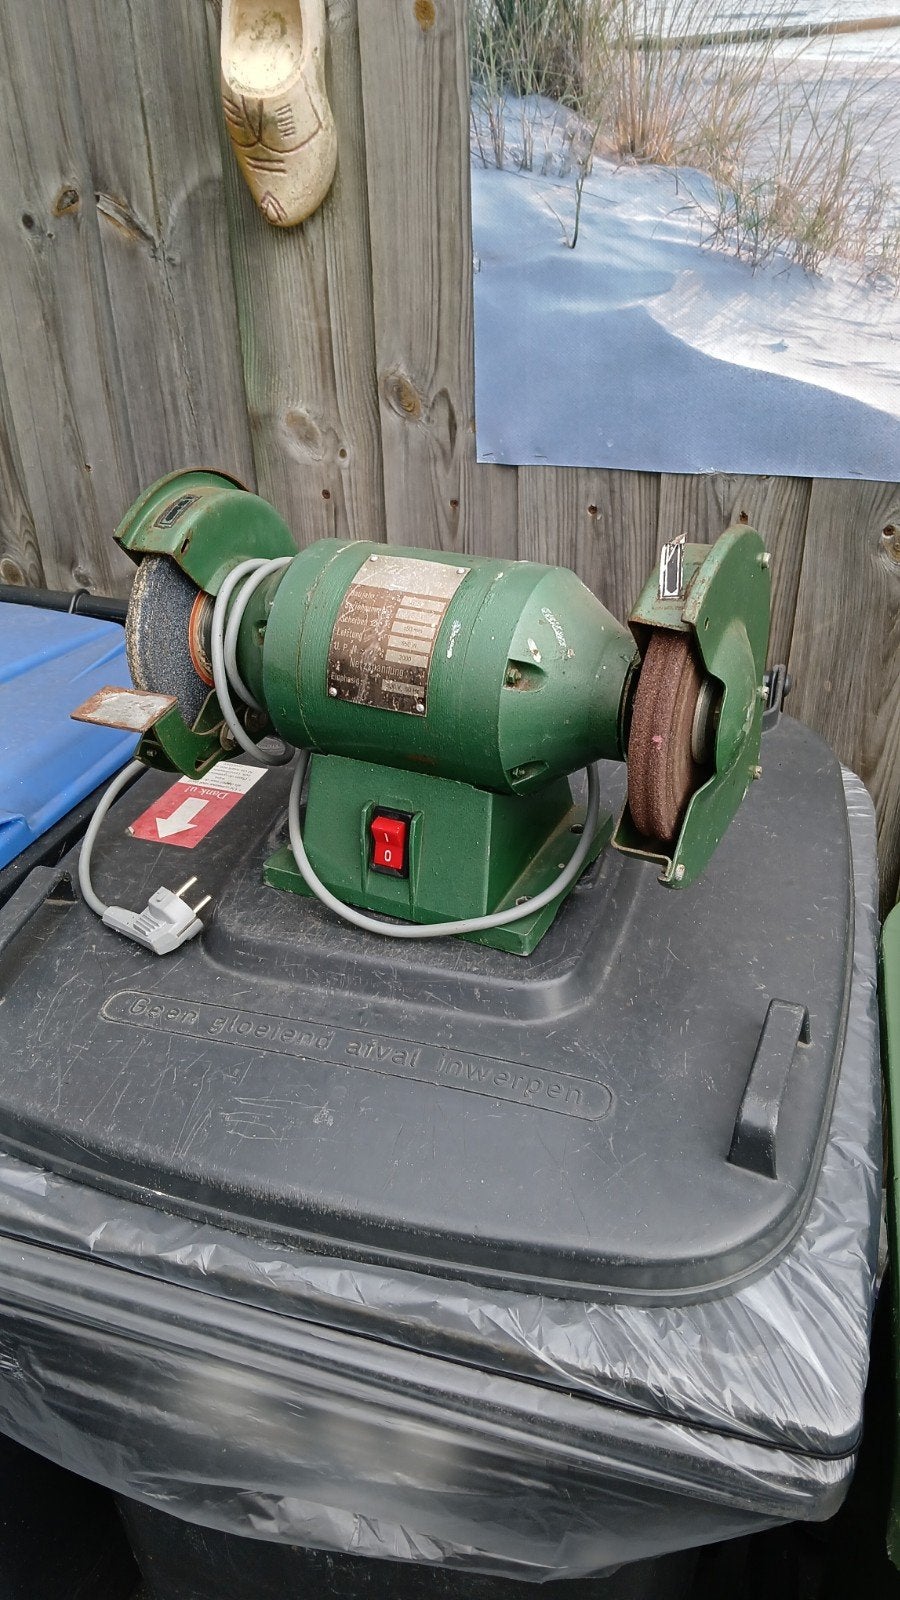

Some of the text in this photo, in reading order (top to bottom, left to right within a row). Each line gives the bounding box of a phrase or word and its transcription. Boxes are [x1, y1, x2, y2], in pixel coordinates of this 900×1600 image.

[184, 785, 198, 793] u!
[201, 788, 229, 800] Dank
[128, 998, 584, 1105] Geen gloeiend afval inwerpen
